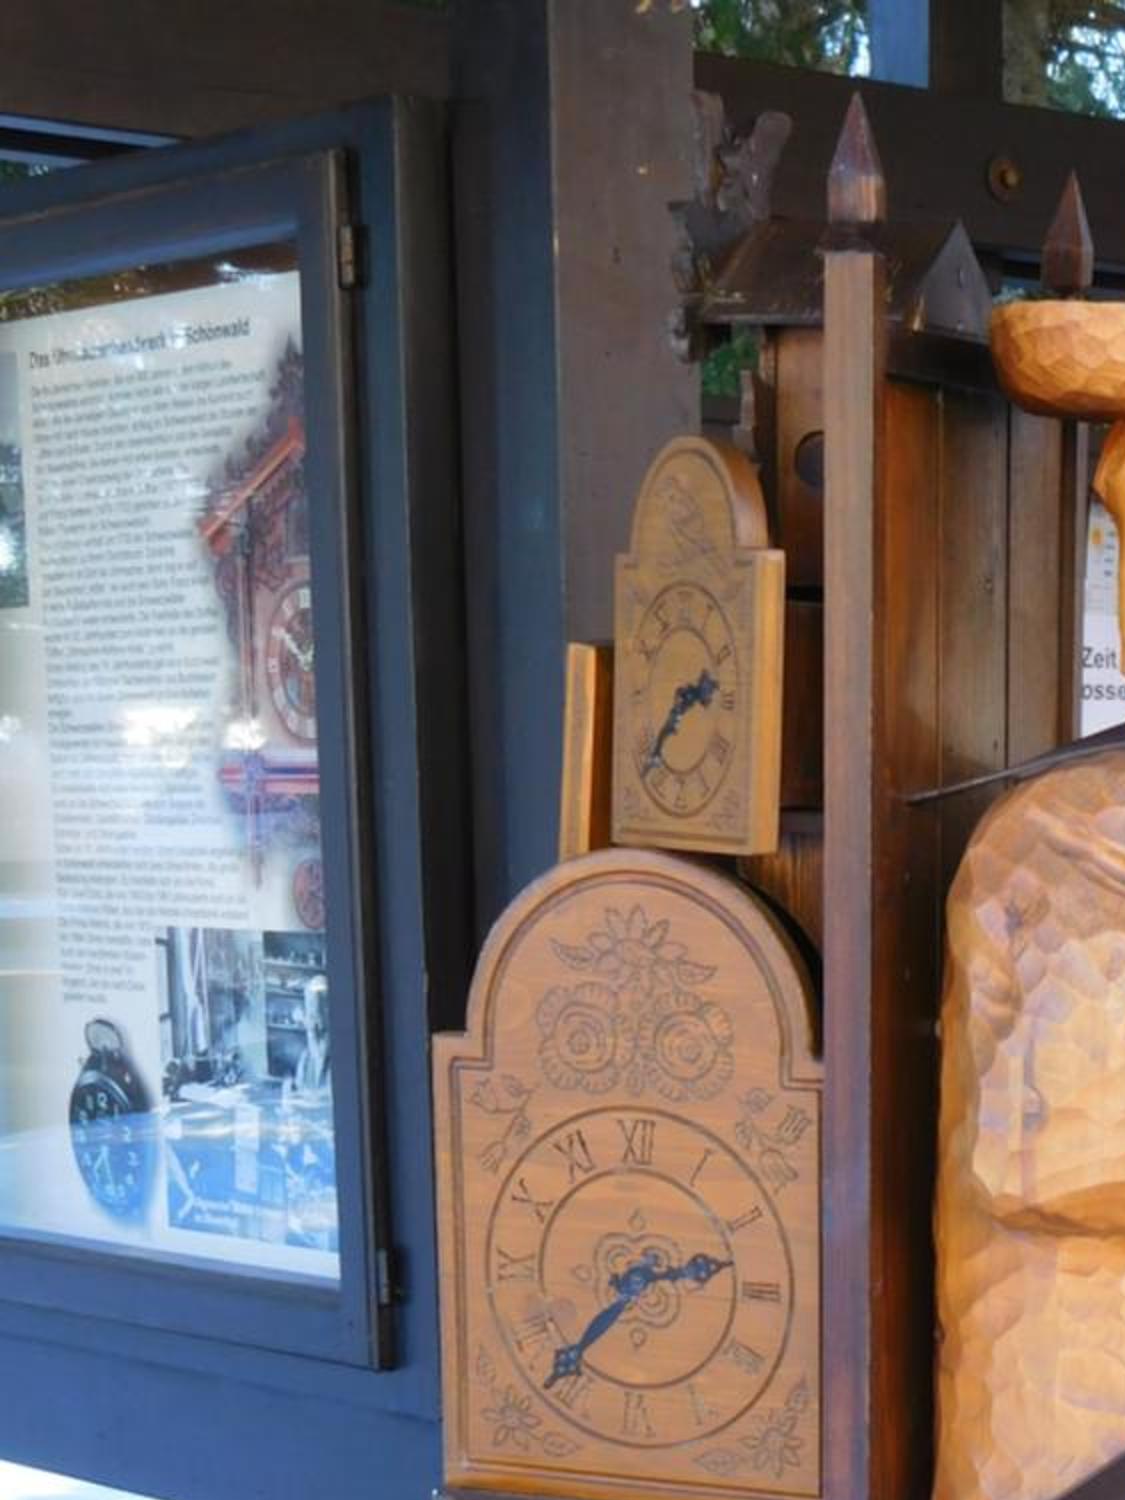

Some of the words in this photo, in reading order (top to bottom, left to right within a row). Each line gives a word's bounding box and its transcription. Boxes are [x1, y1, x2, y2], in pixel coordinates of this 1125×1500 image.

[552, 1128, 596, 1184] XI
[616, 1118, 656, 1165] XII
[742, 1279, 782, 1304] III
